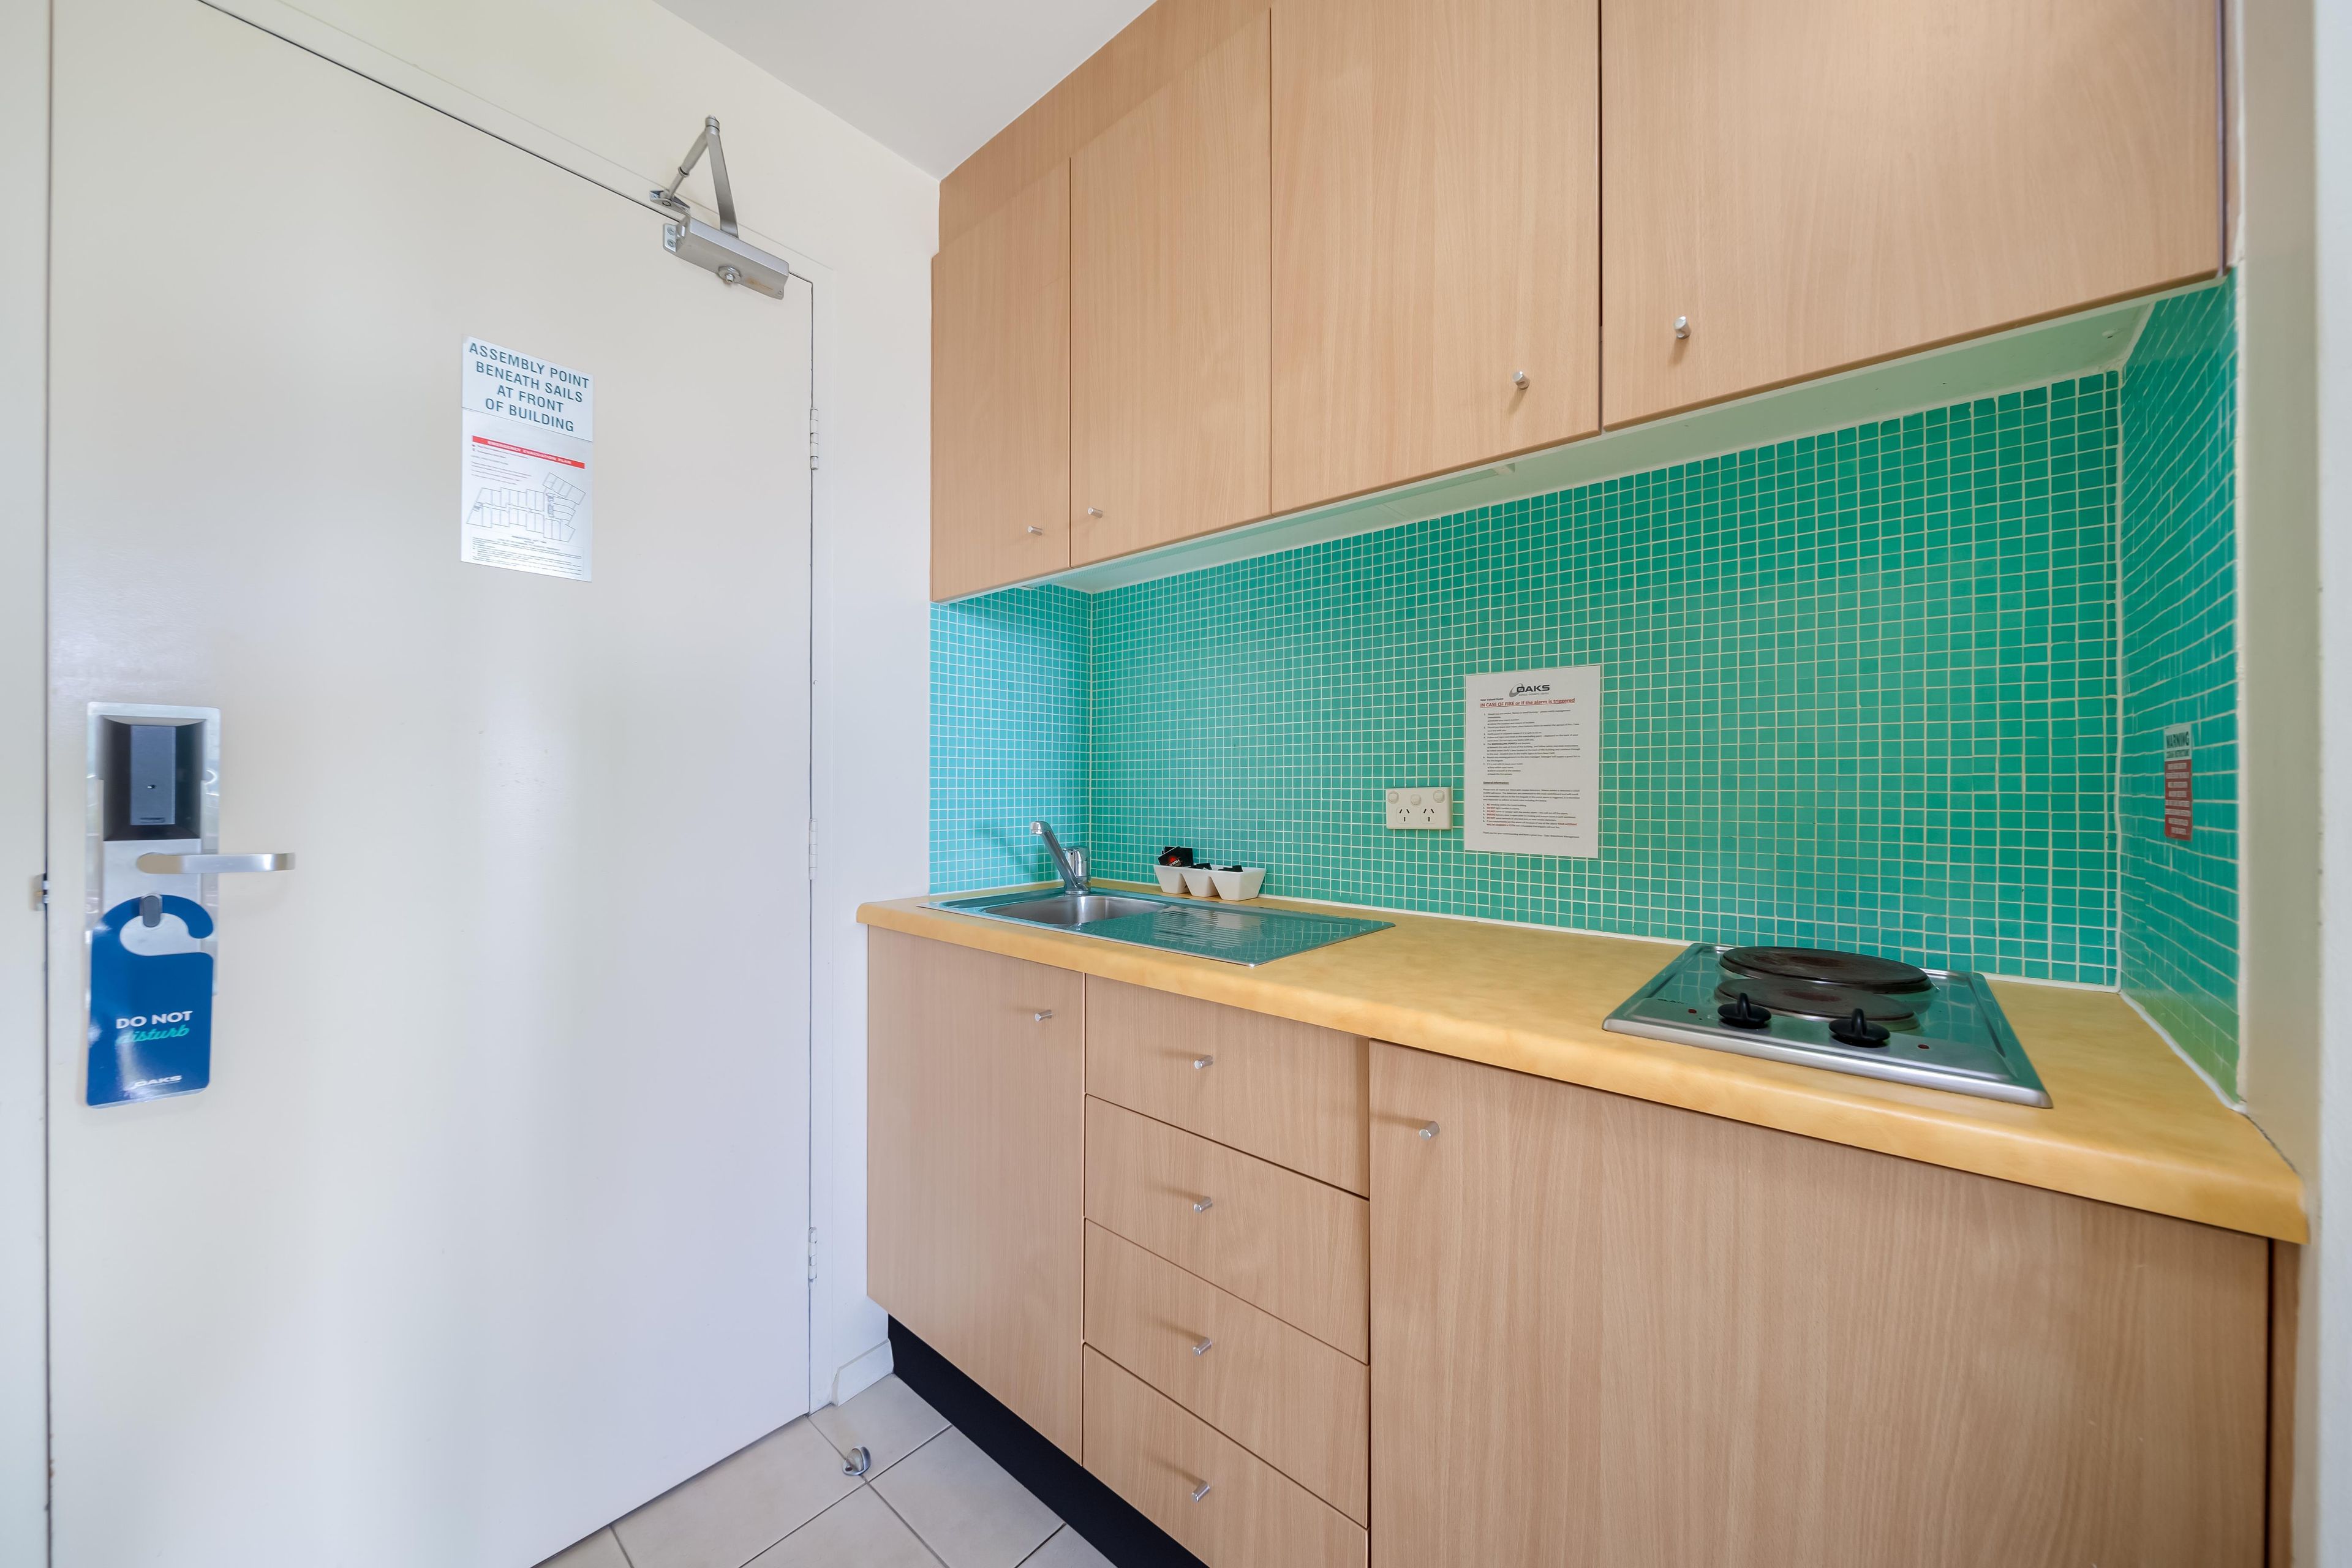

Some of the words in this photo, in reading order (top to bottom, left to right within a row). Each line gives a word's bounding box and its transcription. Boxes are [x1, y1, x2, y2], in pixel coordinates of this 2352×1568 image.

[469, 342, 545, 375] ASSEMBLY
[551, 368, 589, 388] POINT
[476, 361, 540, 390] BENEATH
[545, 382, 582, 402] SAILS
[497, 385, 513, 398] AT
[519, 391, 564, 412] FRONT
[486, 398, 504, 412] OF
[509, 405, 574, 432] BUILDING
[2166, 731, 2190, 748] WARNING
[116, 1016, 147, 1029] DO
[151, 1011, 194, 1025] NOT
[116, 1024, 190, 1044] disturb
